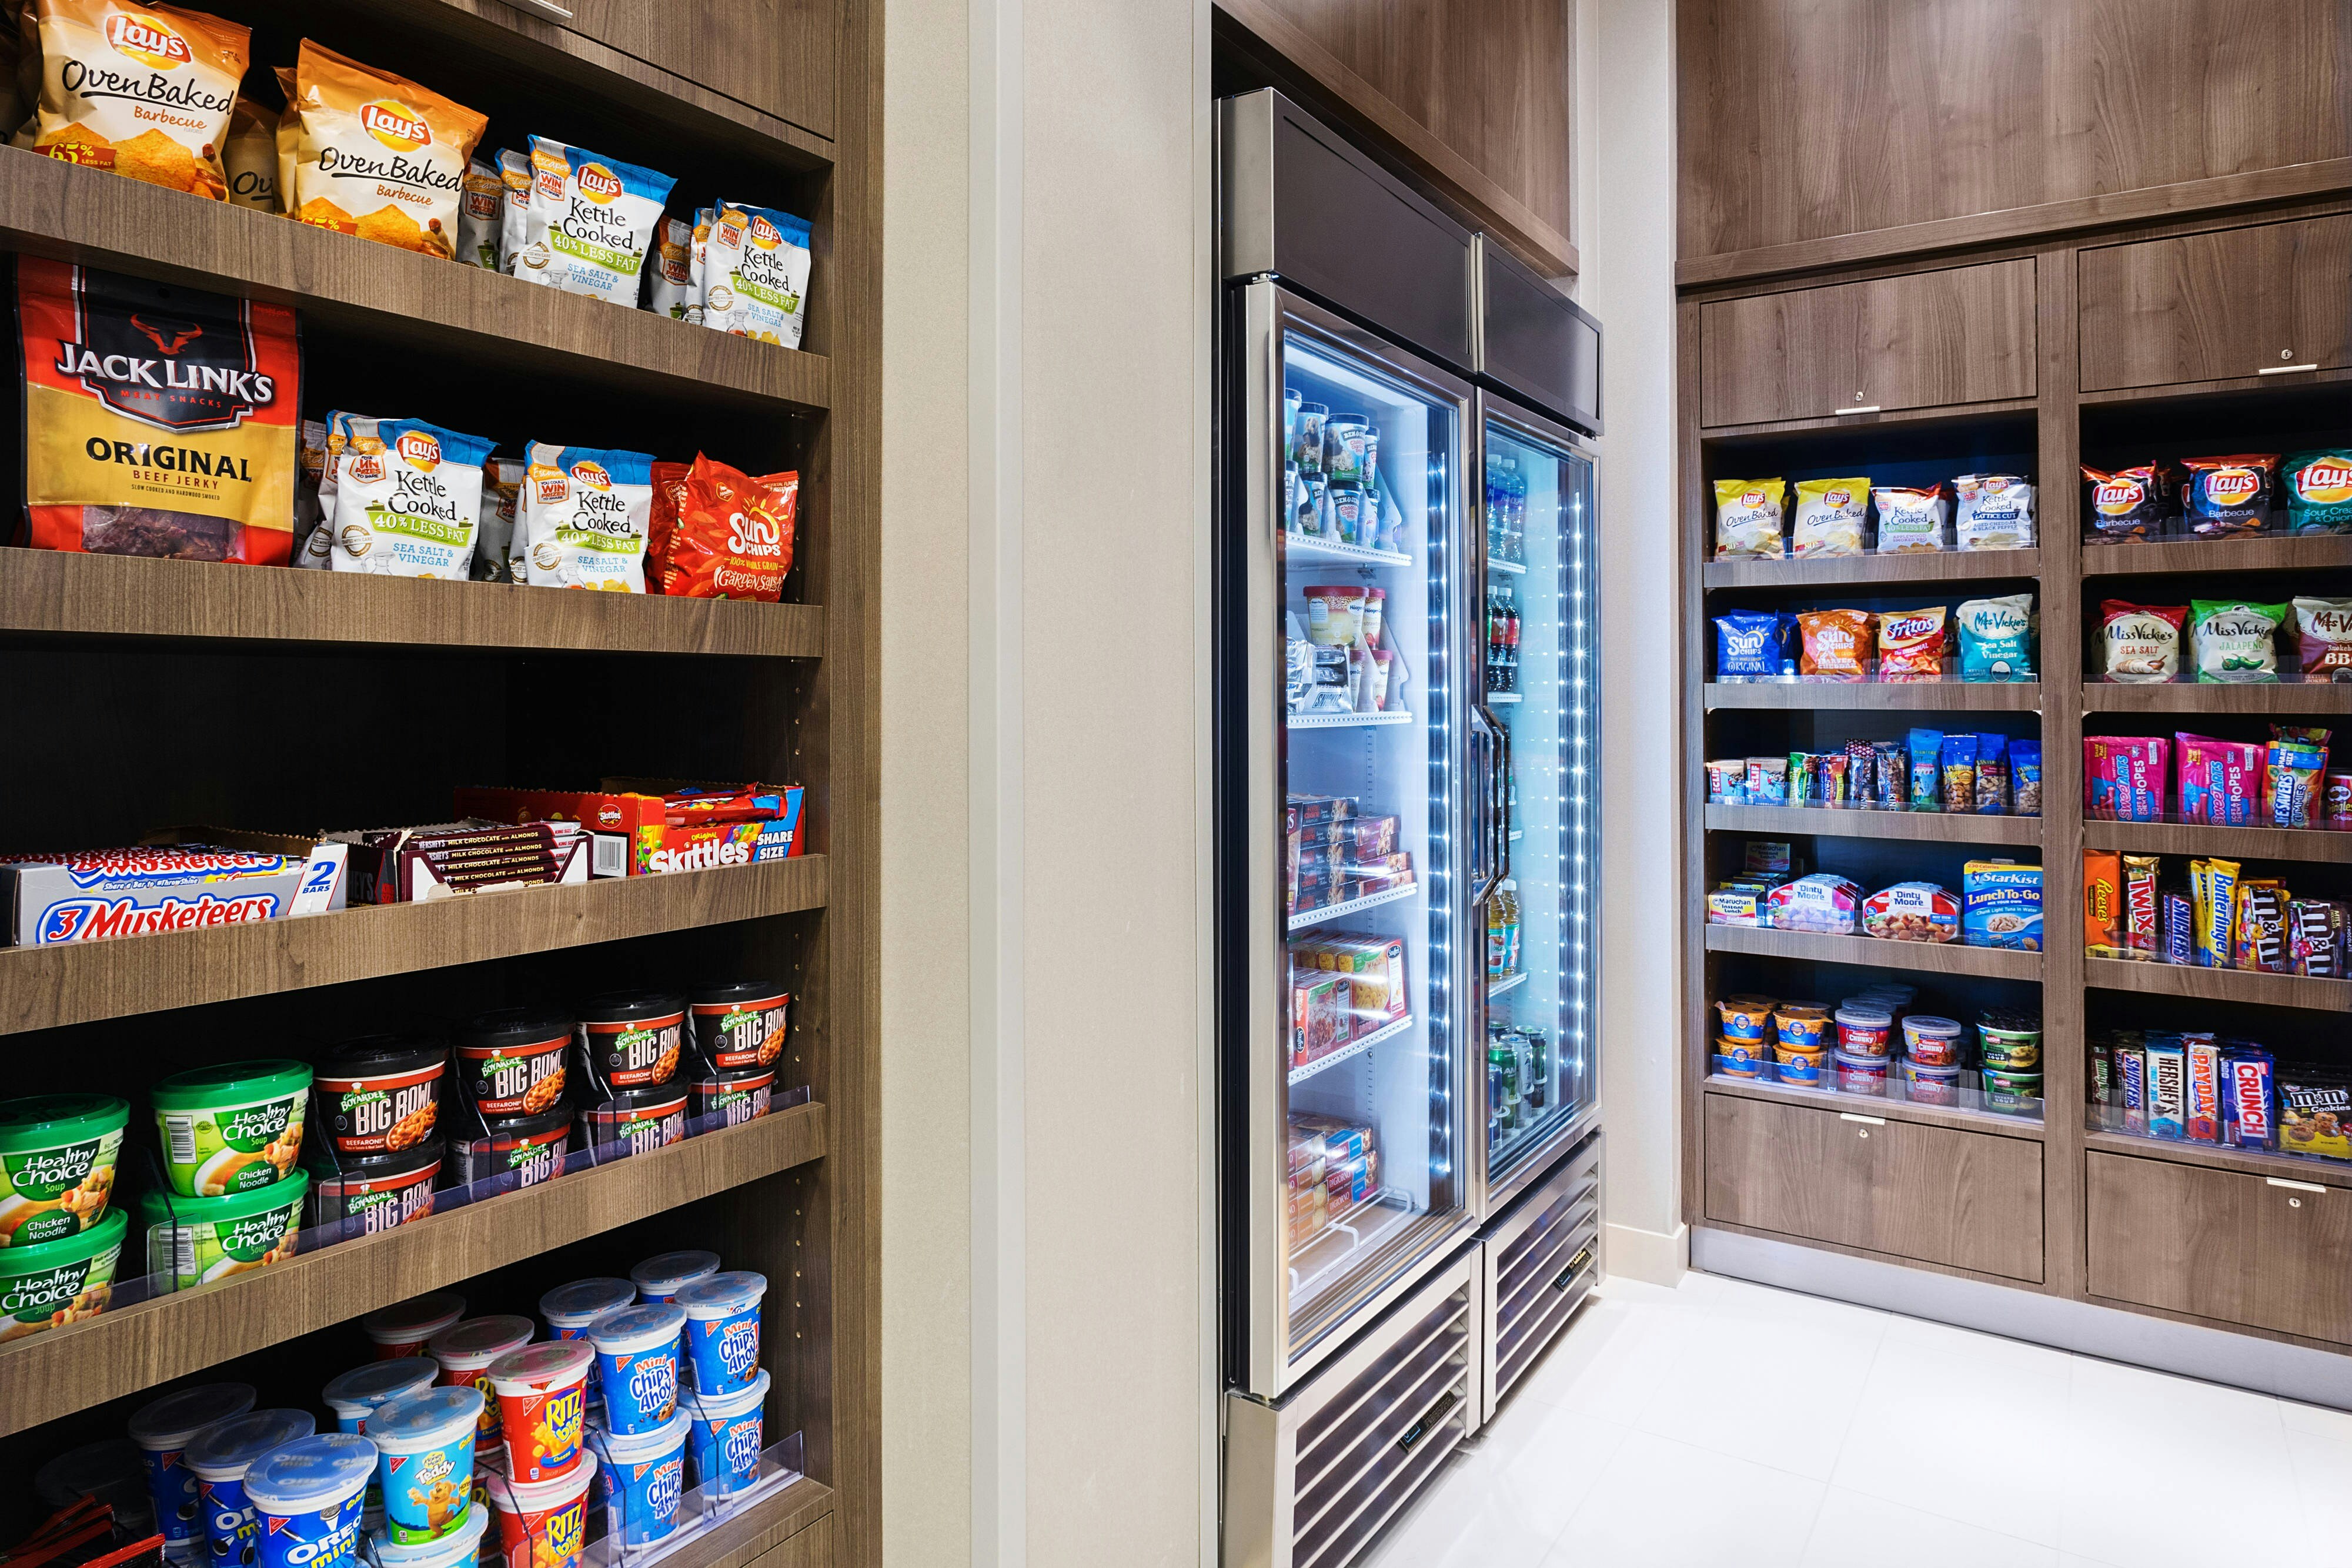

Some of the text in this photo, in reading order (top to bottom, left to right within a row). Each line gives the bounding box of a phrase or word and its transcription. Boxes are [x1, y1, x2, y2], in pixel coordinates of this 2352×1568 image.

[113, 17, 186, 56] Lay's
[134, 106, 207, 129] Barbecue
[541, 174, 563, 188] WIN
[376, 184, 433, 205] Barbecue
[471, 198, 496, 207] WIN
[470, 205, 496, 214] PRIZES
[570, 196, 626, 226] Kettle
[563, 218, 634, 250] Cooked
[554, 235, 637, 272] 40% LESS FAT
[744, 245, 783, 272] Kettle
[567, 263, 586, 275] SEA
[589, 268, 611, 281] SALT
[741, 263, 790, 292] Cooked
[572, 274, 612, 291] VINEGAR
[754, 287, 796, 310] LESS FAT
[747, 303, 779, 319] SEA SALT
[751, 312, 782, 327] VINEGAR
[57, 342, 273, 403] JACK LINK'S
[121, 389, 222, 409] MEAT SNACKS
[85, 437, 252, 483] ORIGINAL
[133, 470, 218, 489] BEEF JERKY
[395, 470, 446, 497] Kettle
[2209, 476, 2254, 494] Lay's
[145, 485, 164, 493] COOKED
[176, 490, 201, 498] HARDWOOD
[1743, 493, 1764, 504] Lay's
[1983, 494, 2008, 504] Kettle
[2096, 486, 2140, 505] Lay's
[388, 493, 457, 520] Cooked
[576, 492, 625, 513] Kettle
[1979, 502, 2012, 512] Cooked
[572, 511, 630, 533] Cooked
[1891, 514, 1927, 524] Cooked
[2096, 519, 2140, 527] Barbecue
[410, 519, 445, 537] LESS
[446, 529, 466, 543] FAT
[592, 536, 636, 551] LESS FAT
[746, 542, 781, 556] CHIPS
[399, 553, 449, 567] VINEGAR
[730, 557, 779, 570] 100% WHOLE GRAIN
[1887, 617, 1934, 640] Fritos
[1993, 611, 2026, 631] Vickie's
[2106, 626, 2136, 640] Miss
[1727, 633, 1764, 656] Sun
[1982, 641, 1997, 650] Sea
[2121, 646, 2159, 654] SEA SALT
[1727, 661, 1769, 672] ORIGINAL
[2278, 748, 2287, 767] SHARE
[2134, 760, 2147, 795] ROPES
[2229, 767, 2243, 805] ROPES
[600, 811, 622, 821] Skittles
[419, 839, 446, 849] HERSHEY'S
[465, 835, 500, 844] CHOCOLATE
[511, 831, 539, 840] ALMONDS
[757, 830, 793, 845] SHARE
[468, 848, 504, 856] CHOCOLATE
[514, 843, 542, 851] ALMONDS
[649, 838, 749, 873] Skittles
[759, 846, 784, 860] SIZE
[308, 861, 336, 886] 2
[1982, 872, 2039, 884] StarKist
[103, 880, 145, 891] Share Bar
[302, 884, 331, 894] BARS
[1800, 885, 1822, 894] Dinty
[1798, 892, 1825, 900] Moore
[1896, 891, 1920, 900] Dinty
[2097, 878, 2113, 923] Reese's
[2129, 874, 2154, 932] TWIX
[48, 897, 271, 938] 3 Musketeers
[2211, 872, 2234, 956] Butterfinger
[2173, 899, 2190, 964] SNICKERS
[1849, 1035, 1874, 1043] CHUNKY
[495, 1064, 527, 1099] BIG
[2159, 1057, 2179, 1115] HERSHEY'S
[2193, 1054, 2216, 1116] PAYDAY
[340, 1090, 387, 1112] BOYARDEE
[2237, 1065, 2265, 1135] CRUNCH
[233, 1105, 291, 1125] Healthy
[355, 1099, 391, 1135] BIG
[222, 1116, 286, 1141] Choice
[251, 1136, 268, 1146] Soup
[346, 1138, 385, 1146] BEEFARONI
[24, 1146, 96, 1171] Healthy
[12, 1161, 91, 1187] Choice
[238, 1167, 272, 1182] Chicken
[239, 1177, 269, 1189] Noodle
[44, 1182, 66, 1193] Soup
[27, 1216, 71, 1231] Chicken
[29, 1225, 67, 1240] Noodle
[636, 1354, 666, 1373] Mini
[630, 1368, 670, 1400] Chips
[546, 1388, 582, 1431] RITZ
[554, 1413, 582, 1441] bits
[416, 1461, 455, 1485] Teddy
[546, 1504, 583, 1545] RITZ
[288, 1514, 361, 1564] OREO
